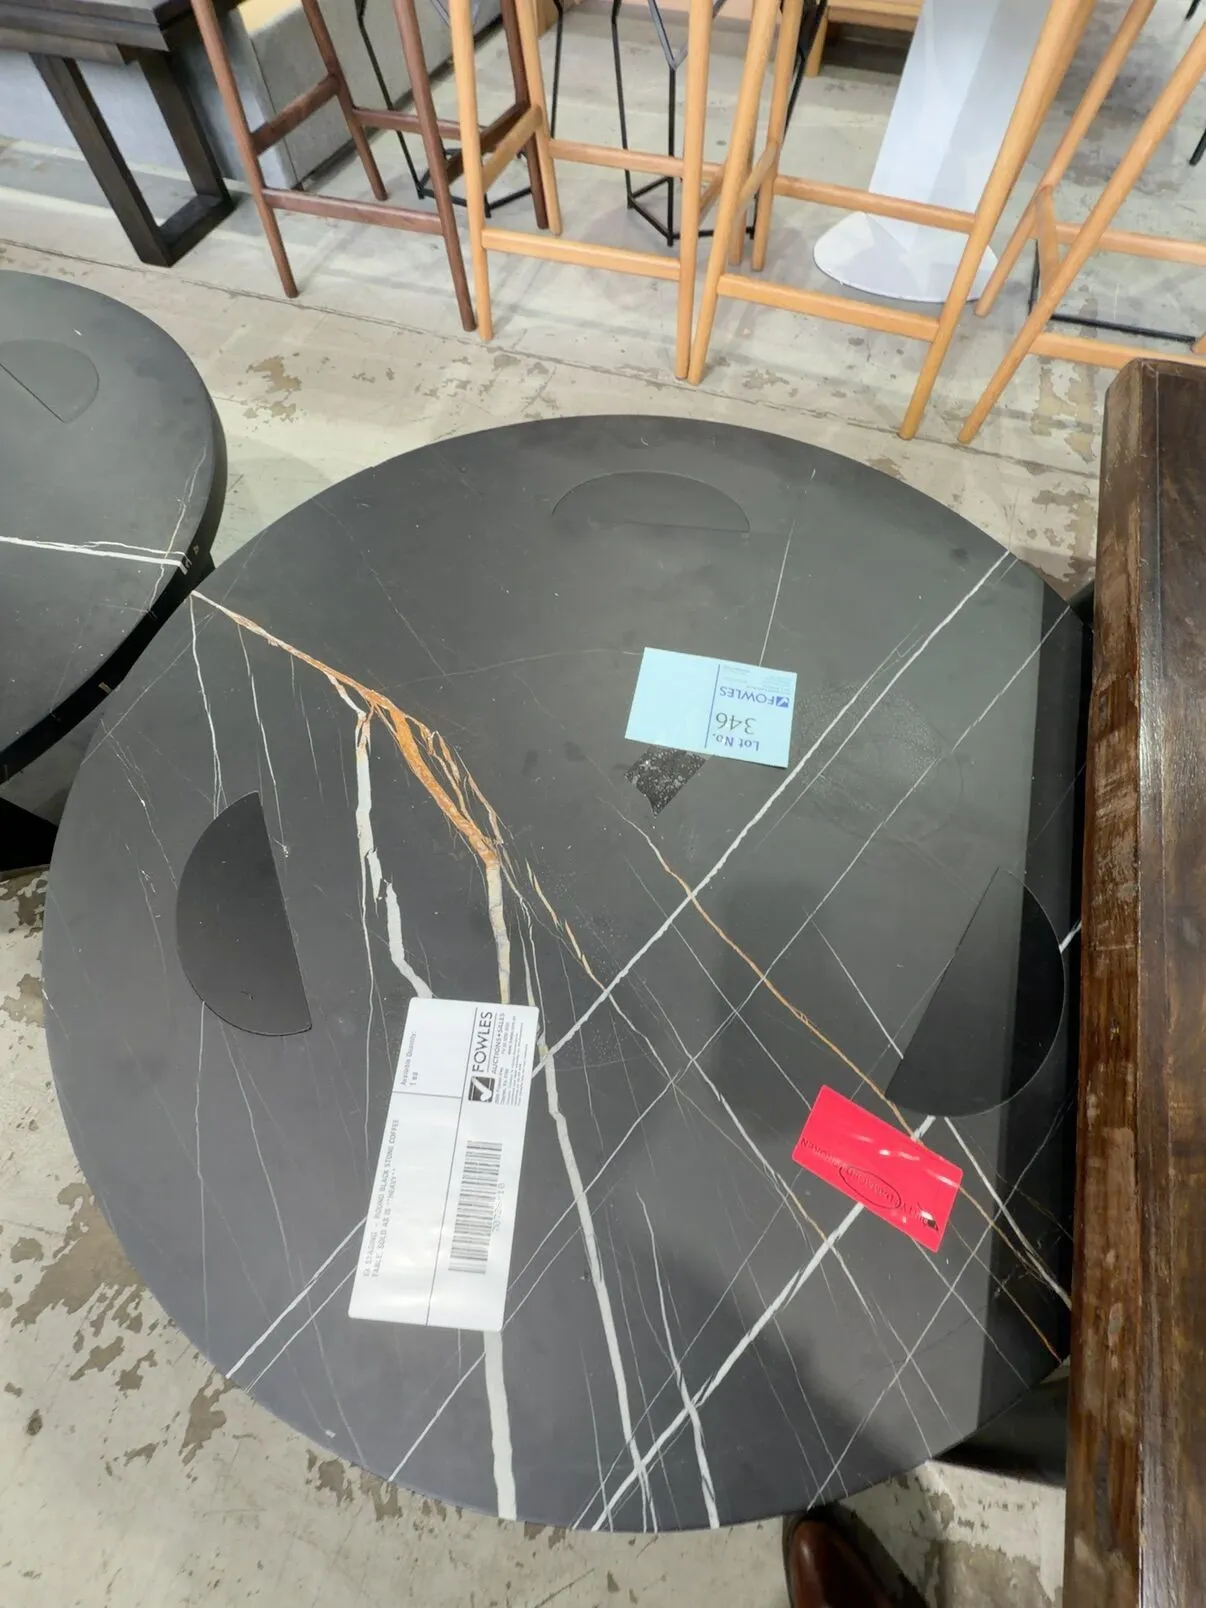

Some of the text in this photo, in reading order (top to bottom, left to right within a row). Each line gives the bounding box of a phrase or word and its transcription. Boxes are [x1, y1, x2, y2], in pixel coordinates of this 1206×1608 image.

[718, 685, 775, 706] FOWLES
[713, 710, 757, 736] 346
[710, 732, 760, 752] Lot No.
[472, 1010, 493, 1072] FOWLES
[389, 1119, 399, 1144] COFFEE
[384, 1145, 394, 1167] STONE
[379, 1169, 389, 1191] BLACK
[374, 1193, 385, 1219] ROUND
[382, 1217, 390, 1227] AS
[365, 1231, 377, 1264] STAGING
[378, 1228, 388, 1249] SOLD
